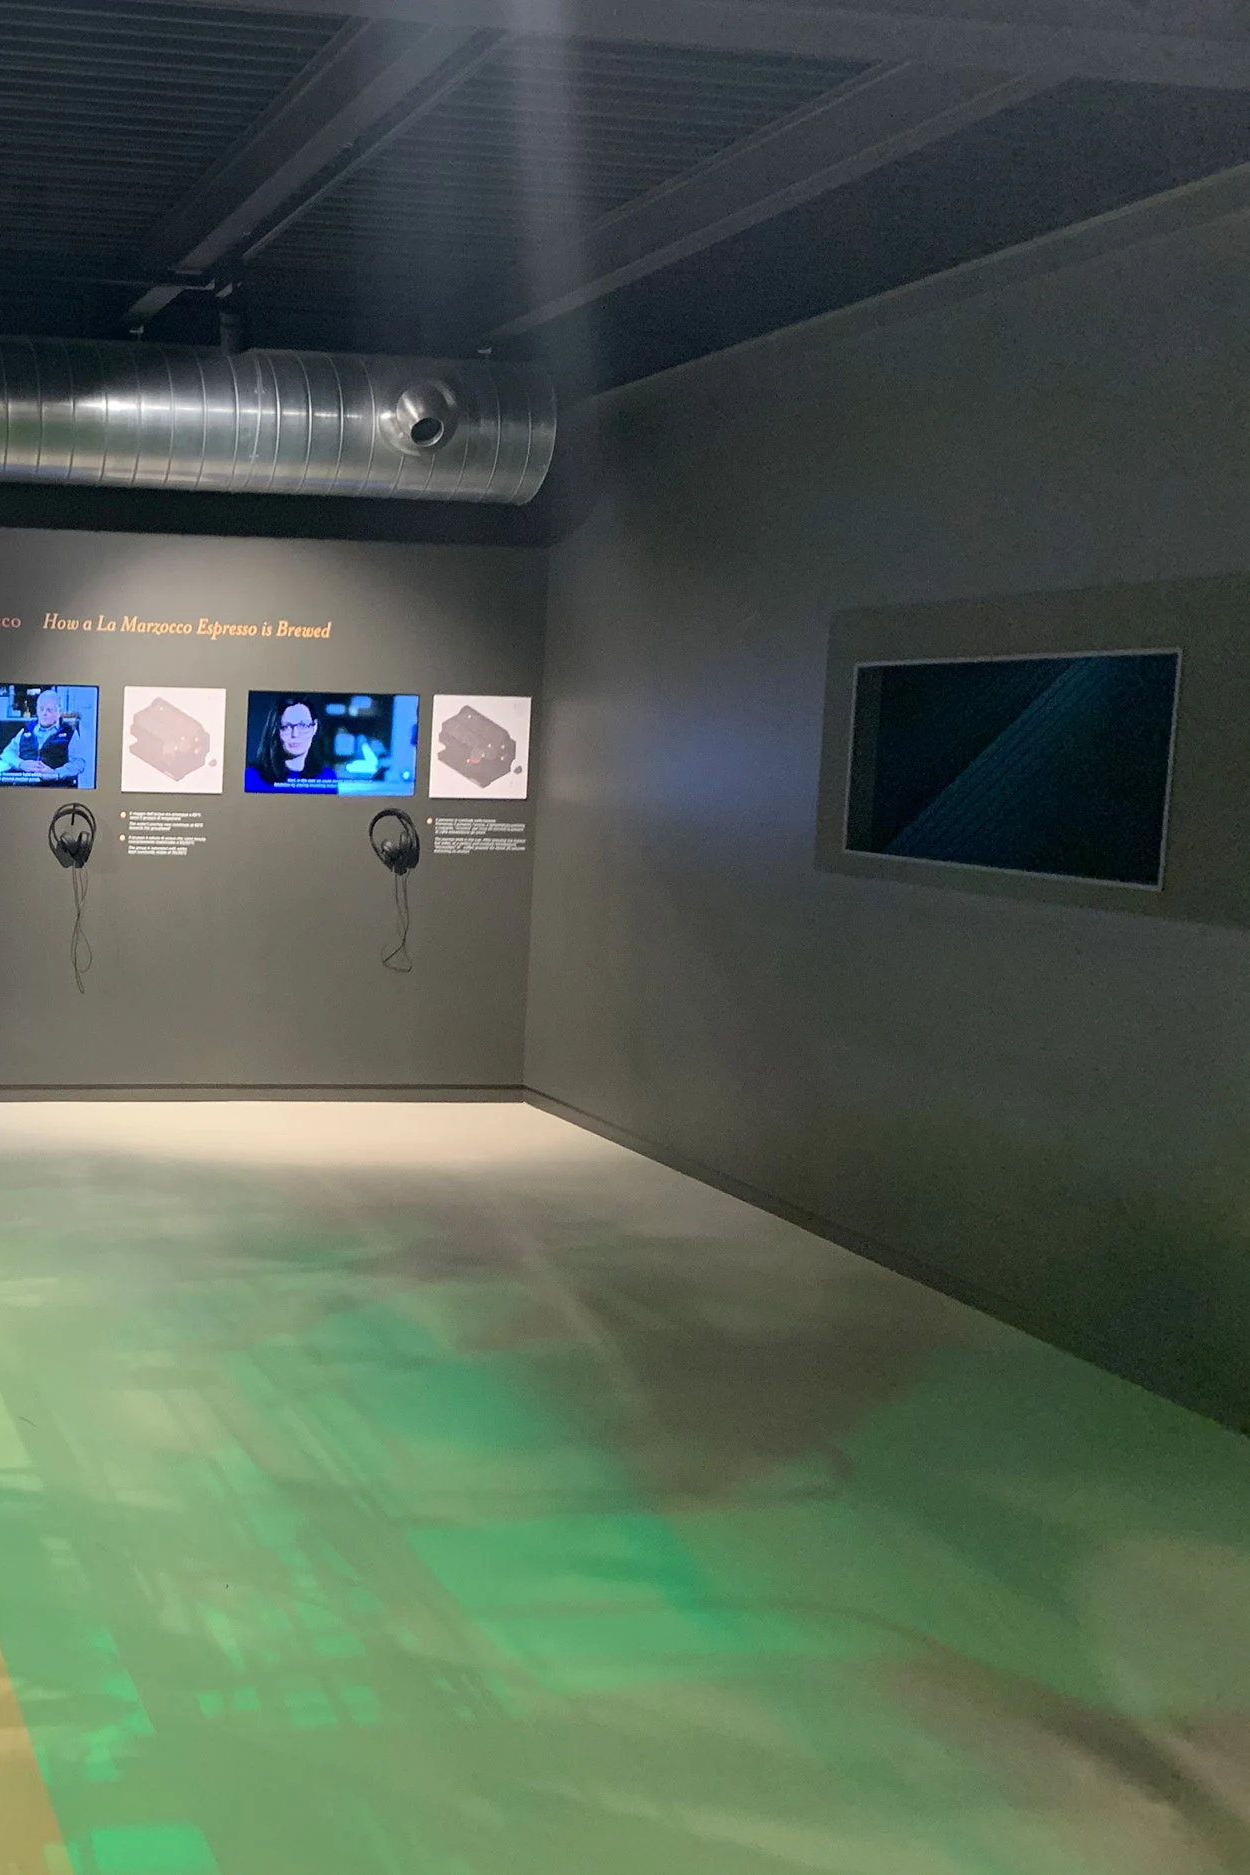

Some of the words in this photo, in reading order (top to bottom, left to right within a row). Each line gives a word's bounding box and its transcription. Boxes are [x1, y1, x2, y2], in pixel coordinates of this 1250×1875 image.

[43, 613, 79, 631] How
[82, 619, 93, 631] a
[96, 615, 116, 632] La
[120, 615, 193, 635] Marzocco
[196, 617, 258, 641] Espresso
[261, 621, 273, 637] is
[276, 620, 332, 639] Brewed
